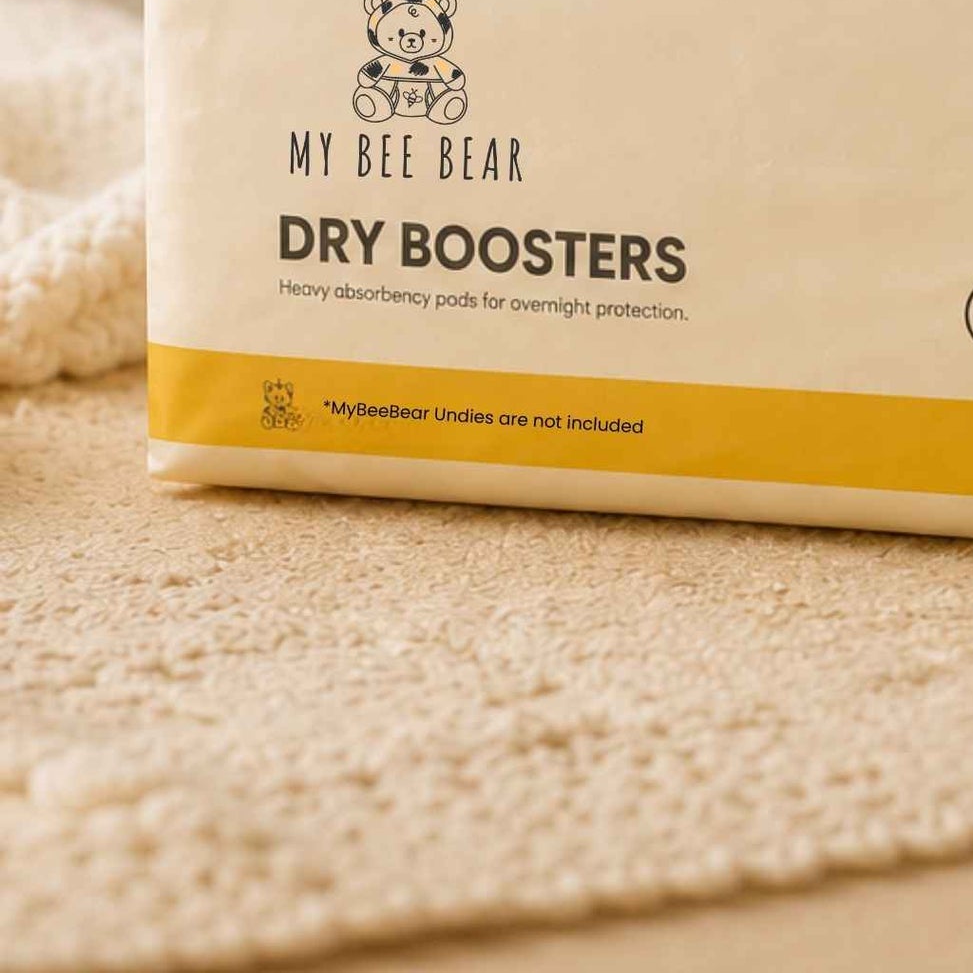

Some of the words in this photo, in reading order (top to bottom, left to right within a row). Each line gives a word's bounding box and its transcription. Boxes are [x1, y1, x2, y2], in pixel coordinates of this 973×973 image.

[290, 131, 331, 176] MY
[358, 134, 413, 178] BEE
[440, 136, 522, 181] BEAR
[280, 215, 385, 265] DRY
[402, 222, 686, 283] BOOSTERS
[280, 280, 330, 301] Heavy
[335, 284, 430, 308] absorbency
[435, 291, 477, 310] pods
[483, 292, 505, 309] for
[597, 302, 689, 321] protection.
[435, 407, 493, 424] Undies
[499, 413, 528, 427] are
[534, 414, 562, 429] not
[567, 415, 643, 433] included
